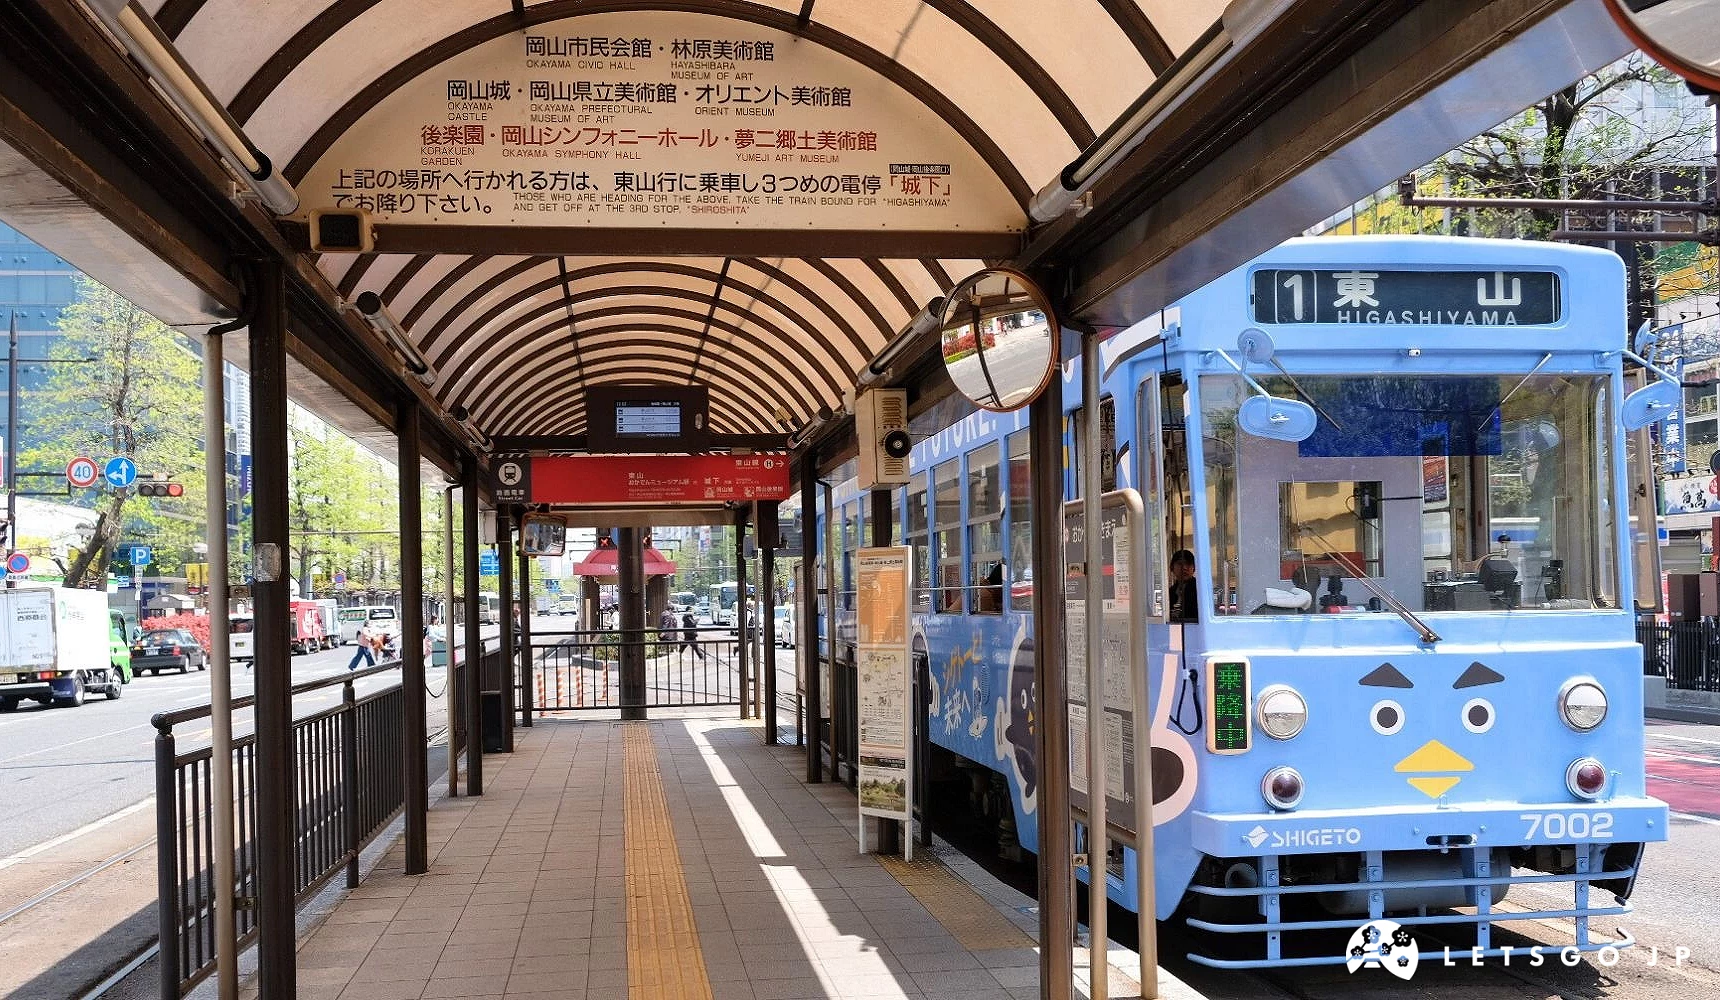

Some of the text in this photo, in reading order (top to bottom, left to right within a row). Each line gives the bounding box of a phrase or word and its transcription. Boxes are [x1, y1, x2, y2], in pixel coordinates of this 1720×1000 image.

[526, 59, 571, 69] OKAYAMA
[610, 61, 635, 70] HALL
[671, 61, 736, 71] HAYASHIBARA
[671, 71, 753, 81] MUSEUM OF ART
[447, 102, 493, 111] OKAYAMA
[530, 104, 652, 114] OKAYAMA PREFECTURAL
[448, 112, 487, 121] CASTLE
[695, 107, 775, 117] ORIENT MUSEUM
[530, 114, 614, 124] MUSEUM OF ART
[421, 147, 475, 156] KORAKUEN
[502, 149, 641, 160] OKAYAMA SYMPHONY HALL
[421, 157, 462, 166] GARDEN
[736, 153, 839, 163] YUMEJI ART MUSEUM
[513, 192, 545, 201] THOSE
[550, 193, 572, 201] WHO
[577, 193, 595, 202] ARE
[601, 193, 643, 202] HEADING
[649, 195, 667, 203] FOR
[673, 195, 691, 203] THE
[736, 196, 760, 204] TAKE
[766, 196, 784, 205] THE
[789, 196, 816, 205] TRAIN
[821, 197, 853, 206] BOUND
[858, 198, 876, 206] FOR
[513, 203, 534, 212] AND
[539, 203, 558, 212] GET
[563, 204, 582, 212] OFF
[588, 204, 600, 212] AT
[606, 204, 624, 213] THE
[630, 204, 648, 213] 3RD
[1284, 274, 1304, 321] 1
[1338, 310, 1517, 326] HIGASHIYAMA
[75, 465, 90, 479] 40
[1216, 664, 1244, 749] 乗降中
[1519, 813, 1614, 840] 7002
[1271, 828, 1361, 847] SHIGETO
